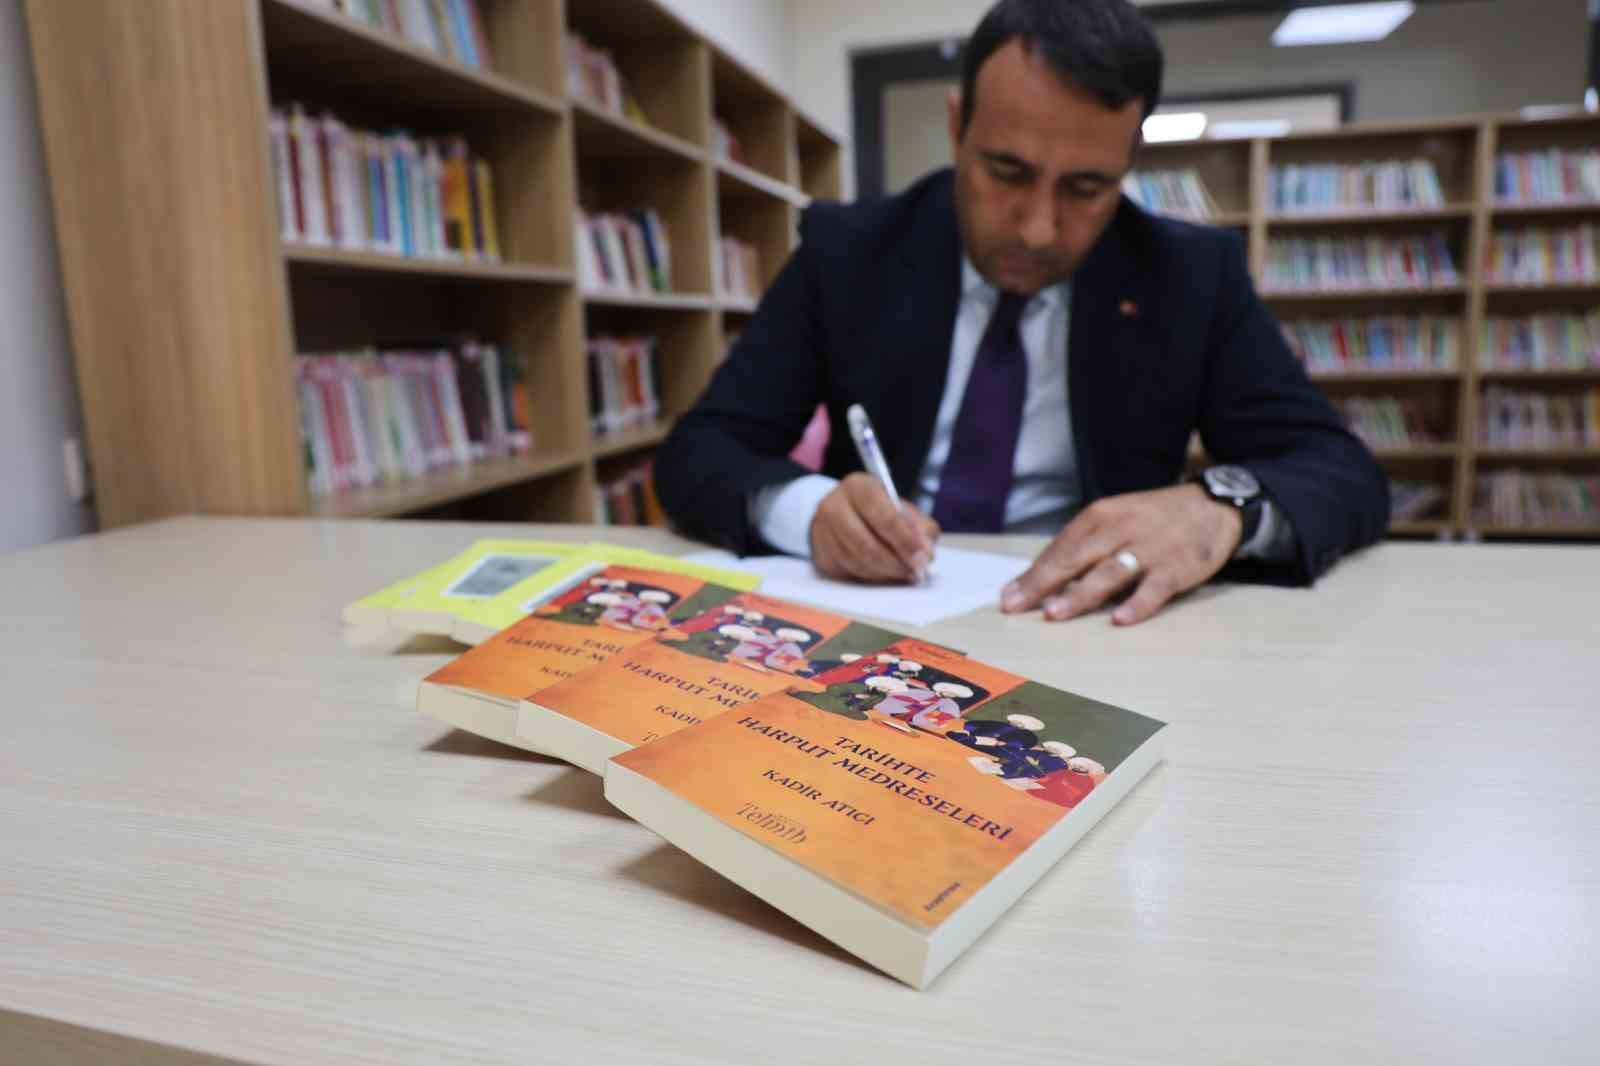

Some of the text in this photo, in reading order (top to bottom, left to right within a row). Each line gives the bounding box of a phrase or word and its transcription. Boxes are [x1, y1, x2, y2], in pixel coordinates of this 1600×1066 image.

[622, 660, 709, 695] HARPUT
[736, 716, 836, 758] HARPUT
[821, 800, 875, 825] ATICI
